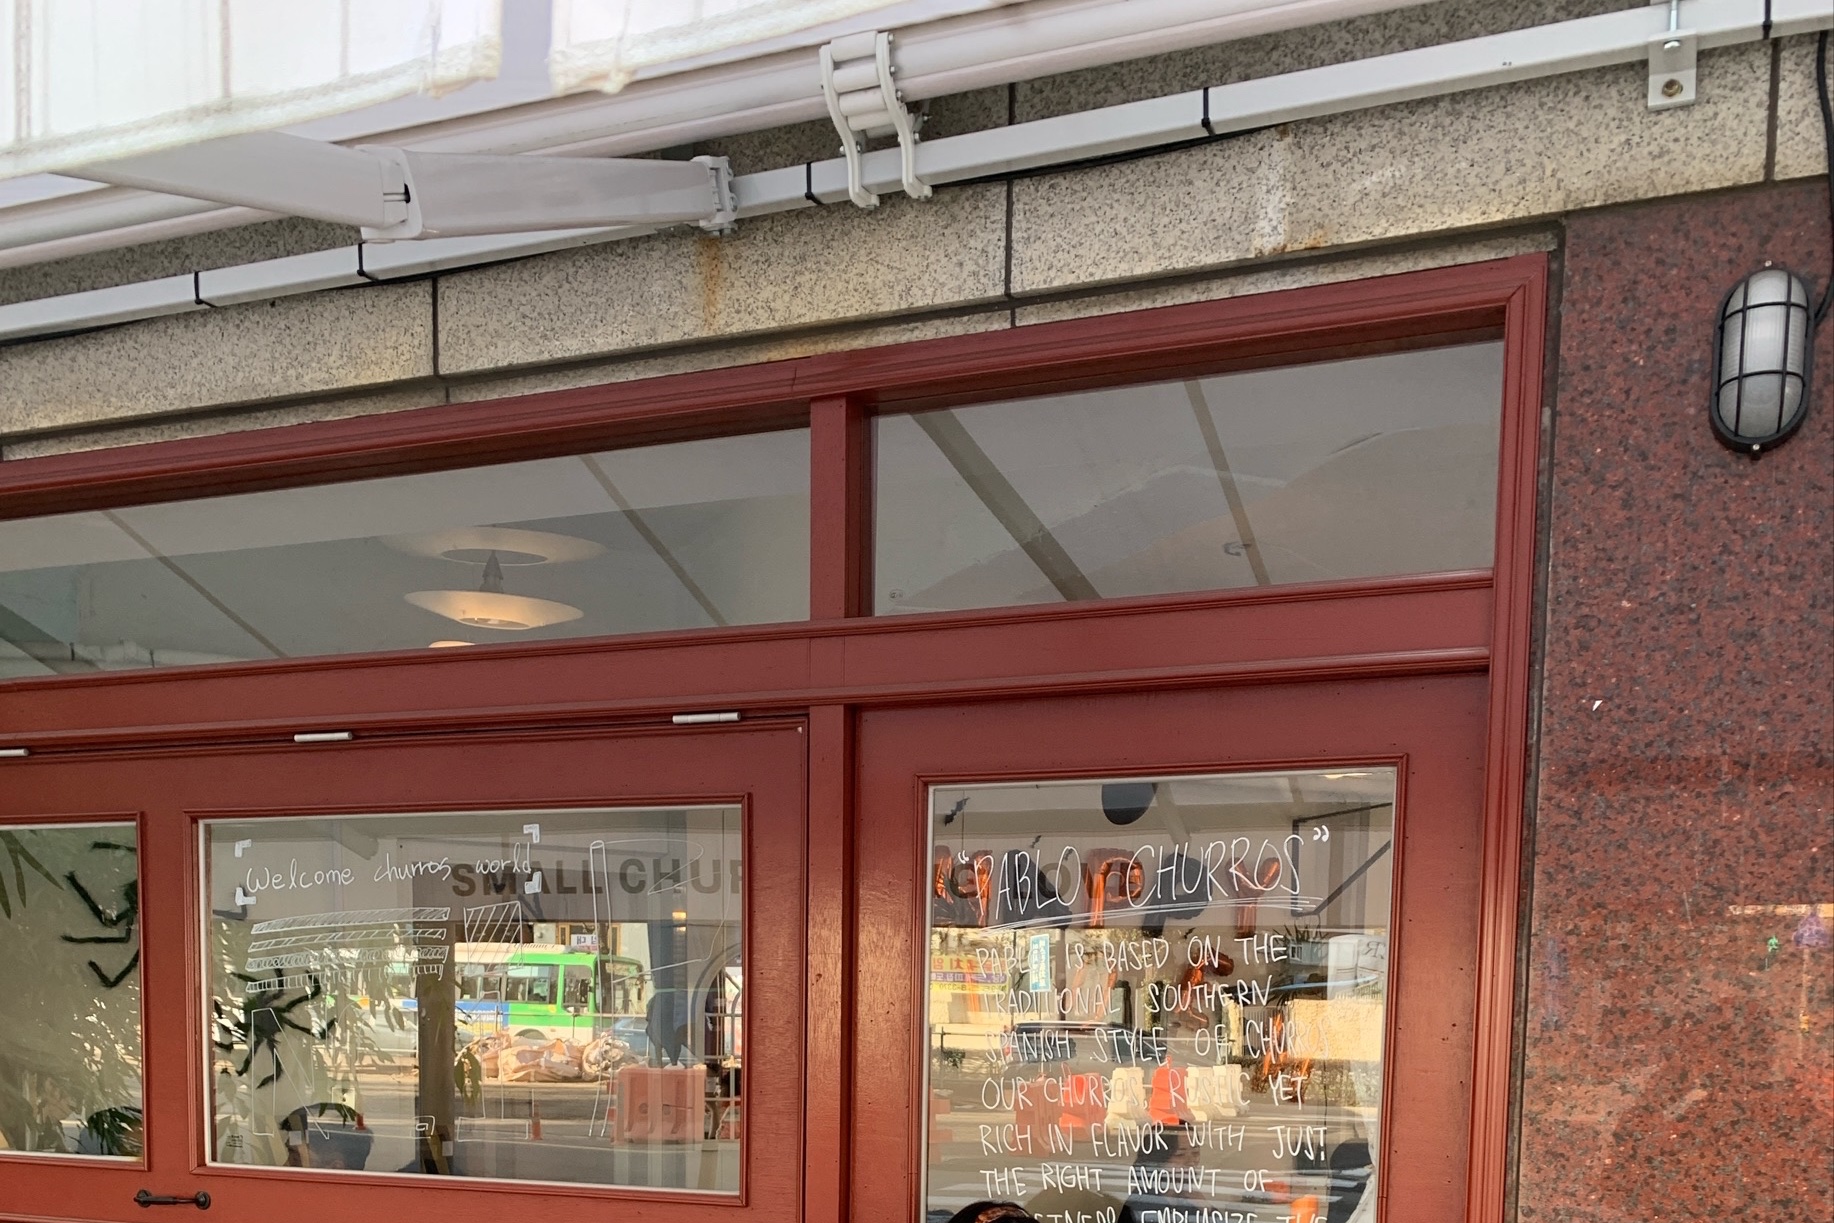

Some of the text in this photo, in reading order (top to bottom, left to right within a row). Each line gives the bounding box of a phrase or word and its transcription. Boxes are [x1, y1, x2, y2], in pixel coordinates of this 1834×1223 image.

[246, 842, 532, 893] Welcome churros world
[451, 858, 602, 898] SMALL
[1066, 942, 1084, 969] IS
[1103, 938, 1170, 973] BASED
[1187, 936, 1225, 967] ON
[1234, 934, 1288, 965] THE
[1148, 975, 1272, 1011] SOUTHERN
[984, 1029, 1071, 1064] SPANISH
[1094, 1027, 1167, 1066] STYLE
[1194, 1022, 1227, 1059] OF
[981, 1077, 1032, 1109] OUR
[1269, 1073, 1306, 1109] YET
[979, 1121, 1327, 1161] RICH IN FLAVOR WITH JUST
[980, 1163, 1273, 1197] THE RIGHT AMOUNT OF
